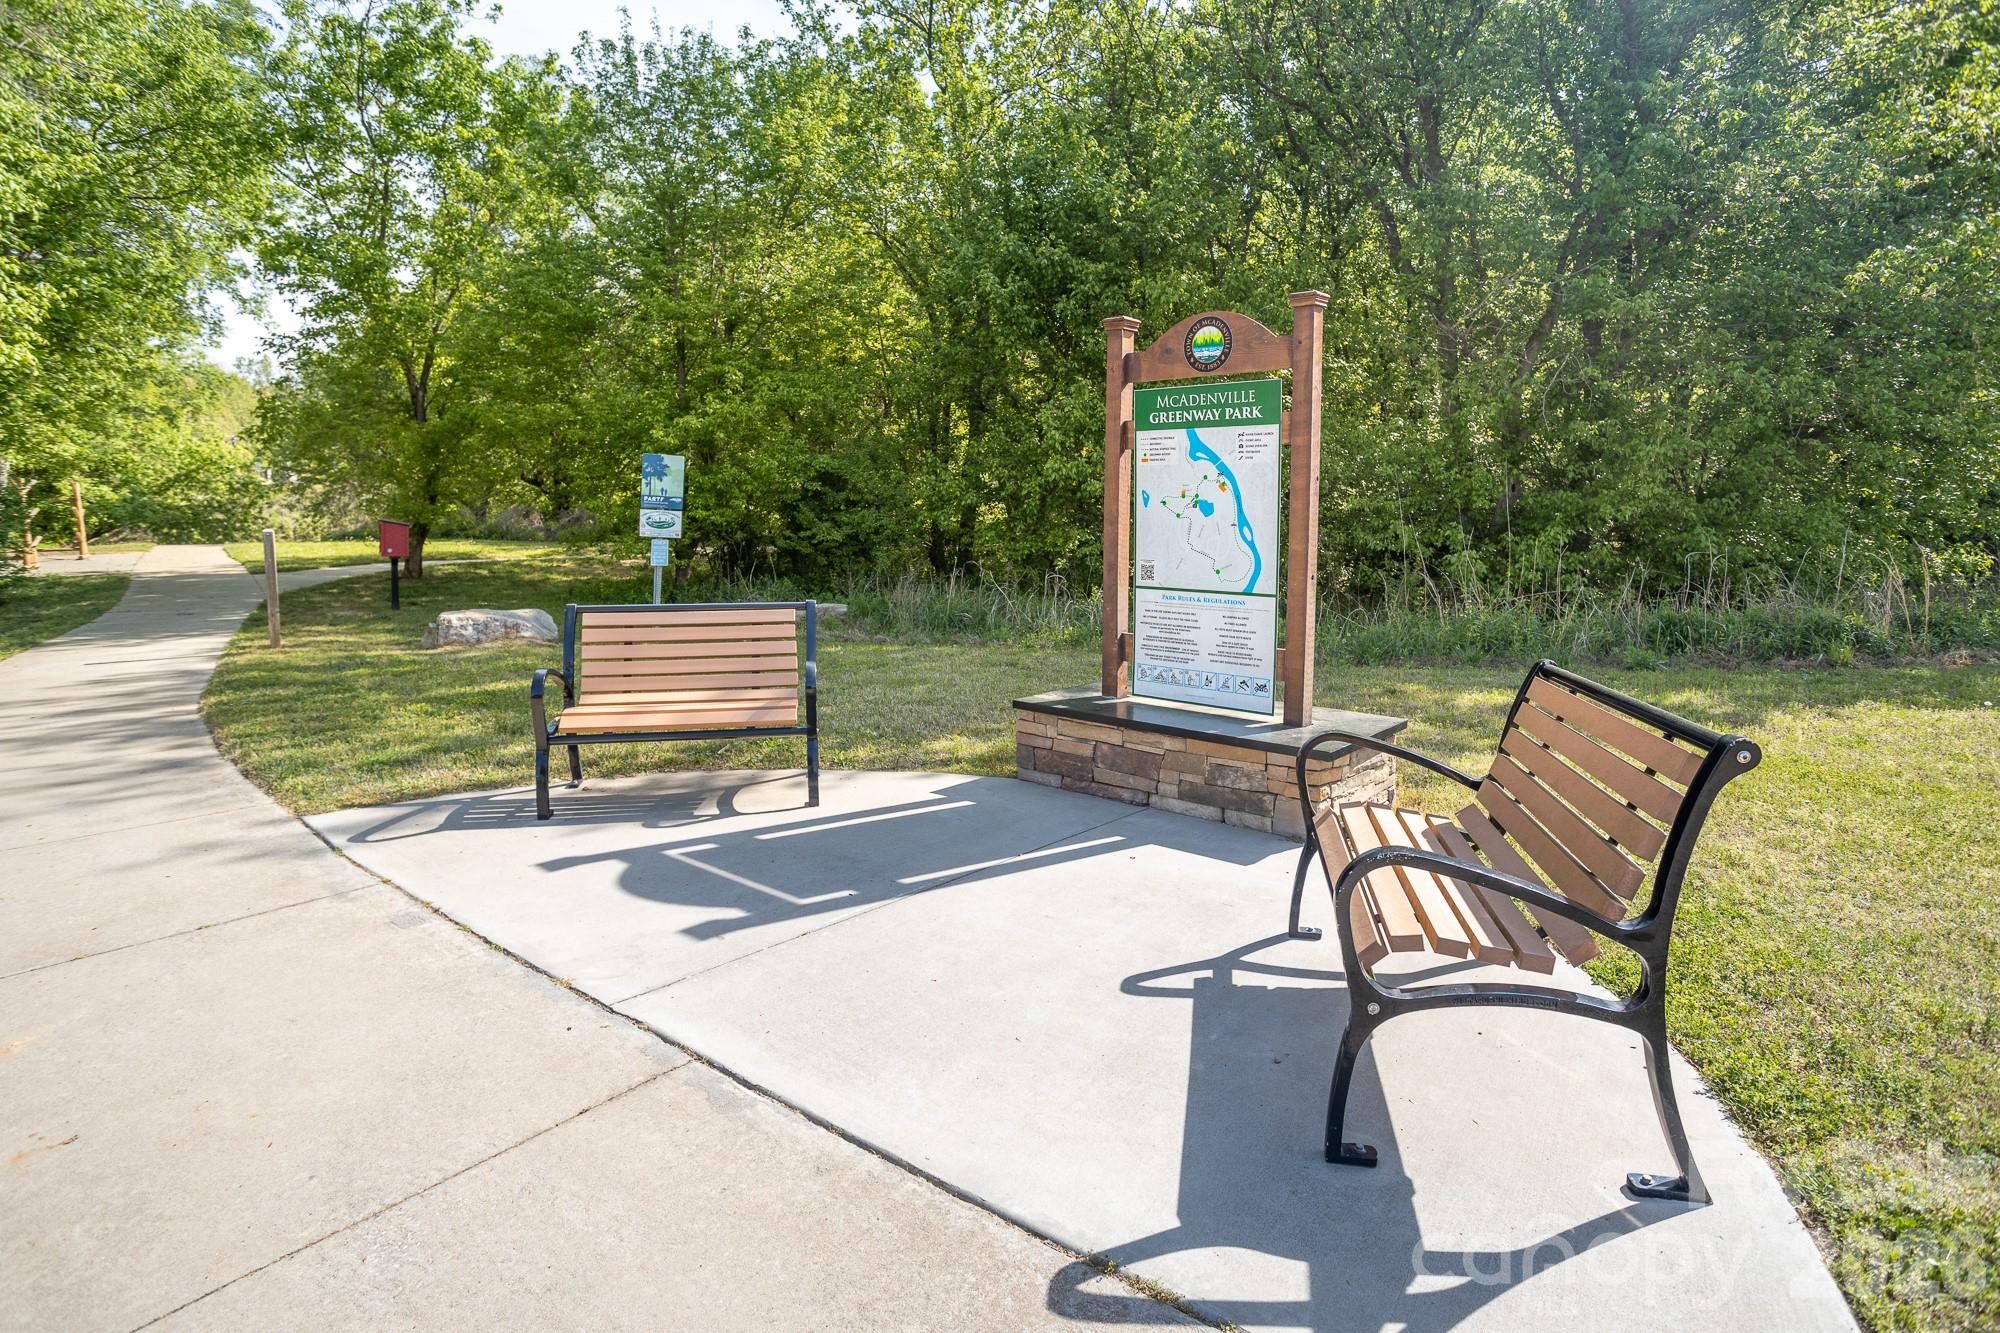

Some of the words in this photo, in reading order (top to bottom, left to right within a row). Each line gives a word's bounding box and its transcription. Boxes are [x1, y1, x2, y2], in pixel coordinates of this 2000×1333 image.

[1185, 333, 1193, 356] TOWN
[1149, 408, 1222, 425] GREENWAY
[1225, 405, 1263, 419] PARK
[1203, 597, 1246, 606] REGULATIONS
